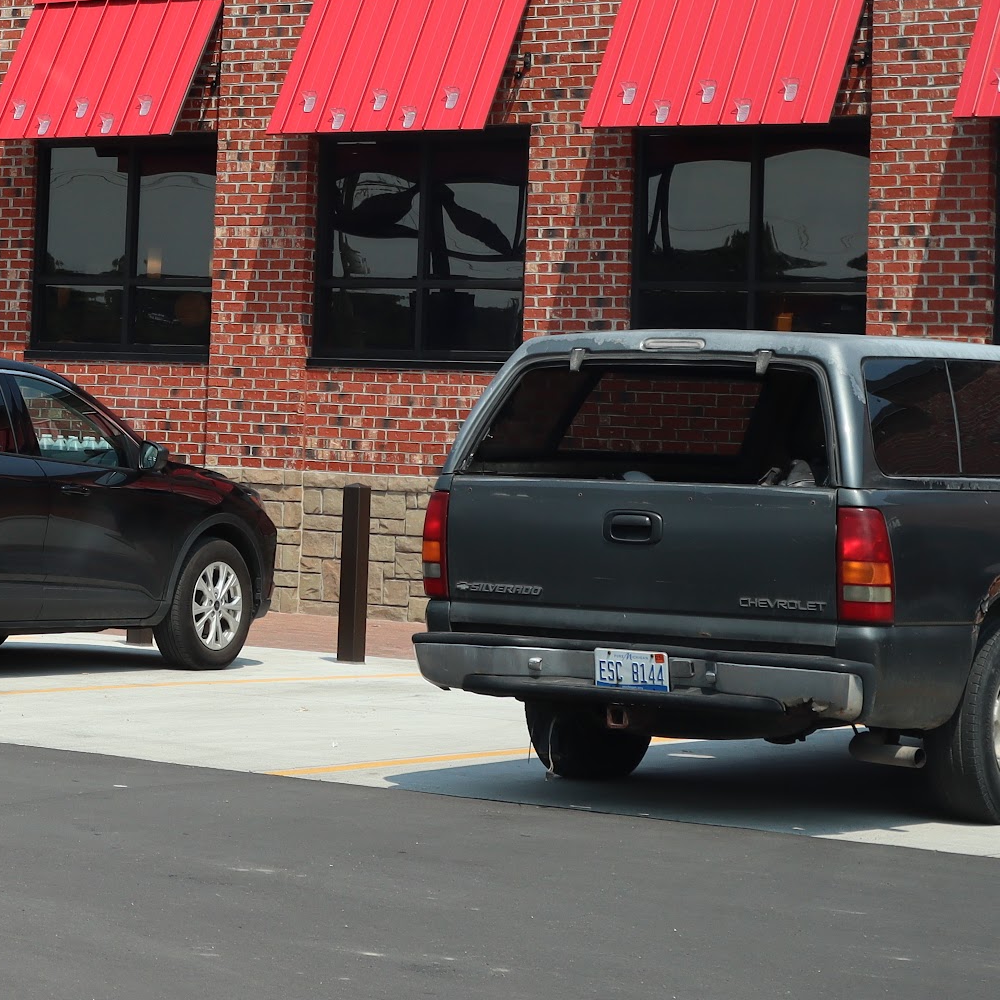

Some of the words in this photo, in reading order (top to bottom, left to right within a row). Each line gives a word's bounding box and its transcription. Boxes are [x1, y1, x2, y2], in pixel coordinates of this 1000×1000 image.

[470, 582, 543, 596] SILVERADO
[740, 597, 827, 611] CHEVROLET
[599, 660, 623, 682] ESC
[631, 662, 665, 686] 8144
